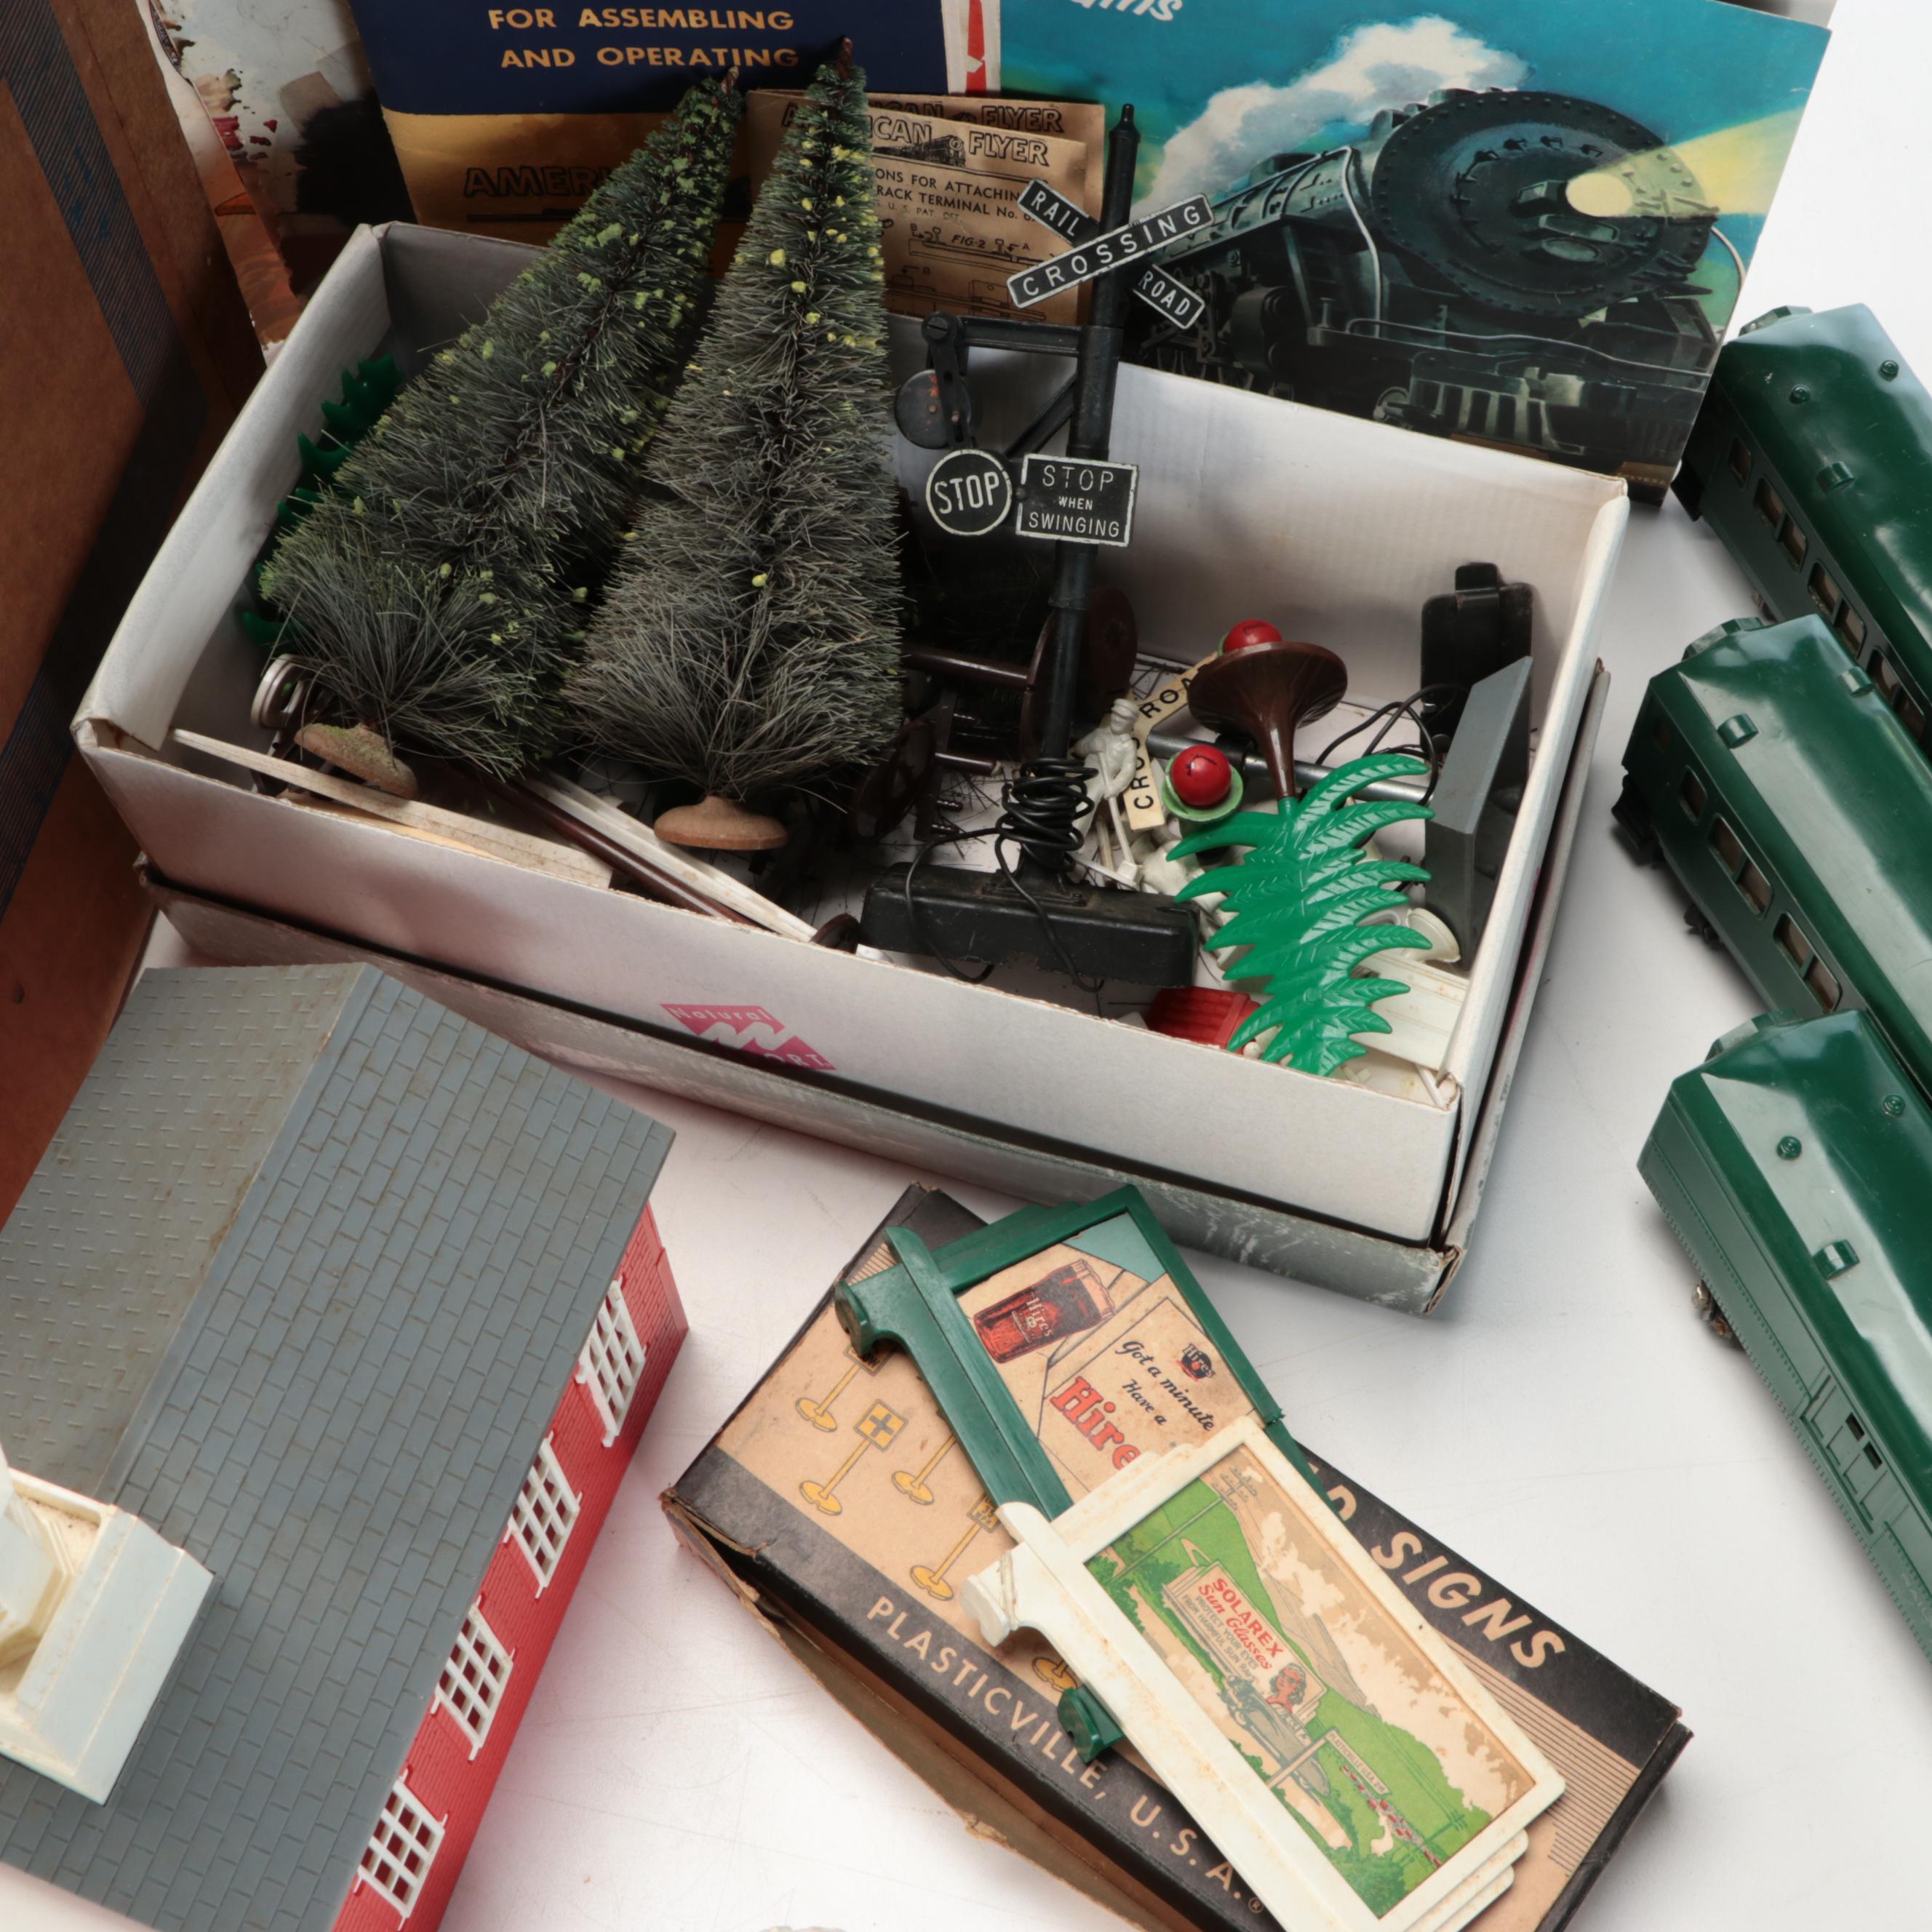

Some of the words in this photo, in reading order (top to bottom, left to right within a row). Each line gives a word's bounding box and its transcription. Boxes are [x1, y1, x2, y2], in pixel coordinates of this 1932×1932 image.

[488, 9, 556, 30] FOR
[578, 9, 794, 31] ASSEMBLING
[501, 49, 575, 68] AND
[596, 47, 799, 68] OPERATING
[982, 105, 1065, 133] FLYER
[969, 131, 1050, 167] FLYER
[463, 166, 610, 197] AMER
[911, 175, 937, 189] FOR
[945, 180, 1020, 202] ATTACHIN
[919, 193, 990, 215] TERMINAL
[997, 206, 1018, 220] No.
[1022, 205, 1201, 297] CROSSING
[1031, 191, 1080, 237] RAIL
[1138, 271, 1191, 316] ROAD
[934, 471, 1000, 515] STOP
[1042, 464, 1114, 492] STOP
[1058, 495, 1093, 511] WHEN
[1029, 511, 1120, 538] SWINGING
[668, 1007, 773, 1021] Natural
[1181, 1343, 1216, 1378] Hires
[1115, 1340, 1153, 1365] Got
[1148, 1365, 1162, 1379] a
[1160, 1377, 1216, 1432] minute
[1122, 1379, 1155, 1413] Have
[1154, 1413, 1168, 1426] a
[1049, 1376, 1141, 1472] Hire
[1213, 1578, 1283, 1658] SOLAREX
[1370, 1531, 1566, 1668] SIGNS
[1182, 1594, 1199, 1614] FROM
[1197, 1614, 1226, 1647] HARMFUL
[1224, 1646, 1241, 1664] SUN
[1195, 1595, 1224, 1627] PROTECT
[1224, 1628, 1242, 1649] YOUR
[1240, 1650, 1259, 1669] EYES
[1198, 1584, 1226, 1614] Sun
[1226, 1617, 1272, 1669] Glasses
[866, 1596, 1109, 1800] PLASTICVILLE,
